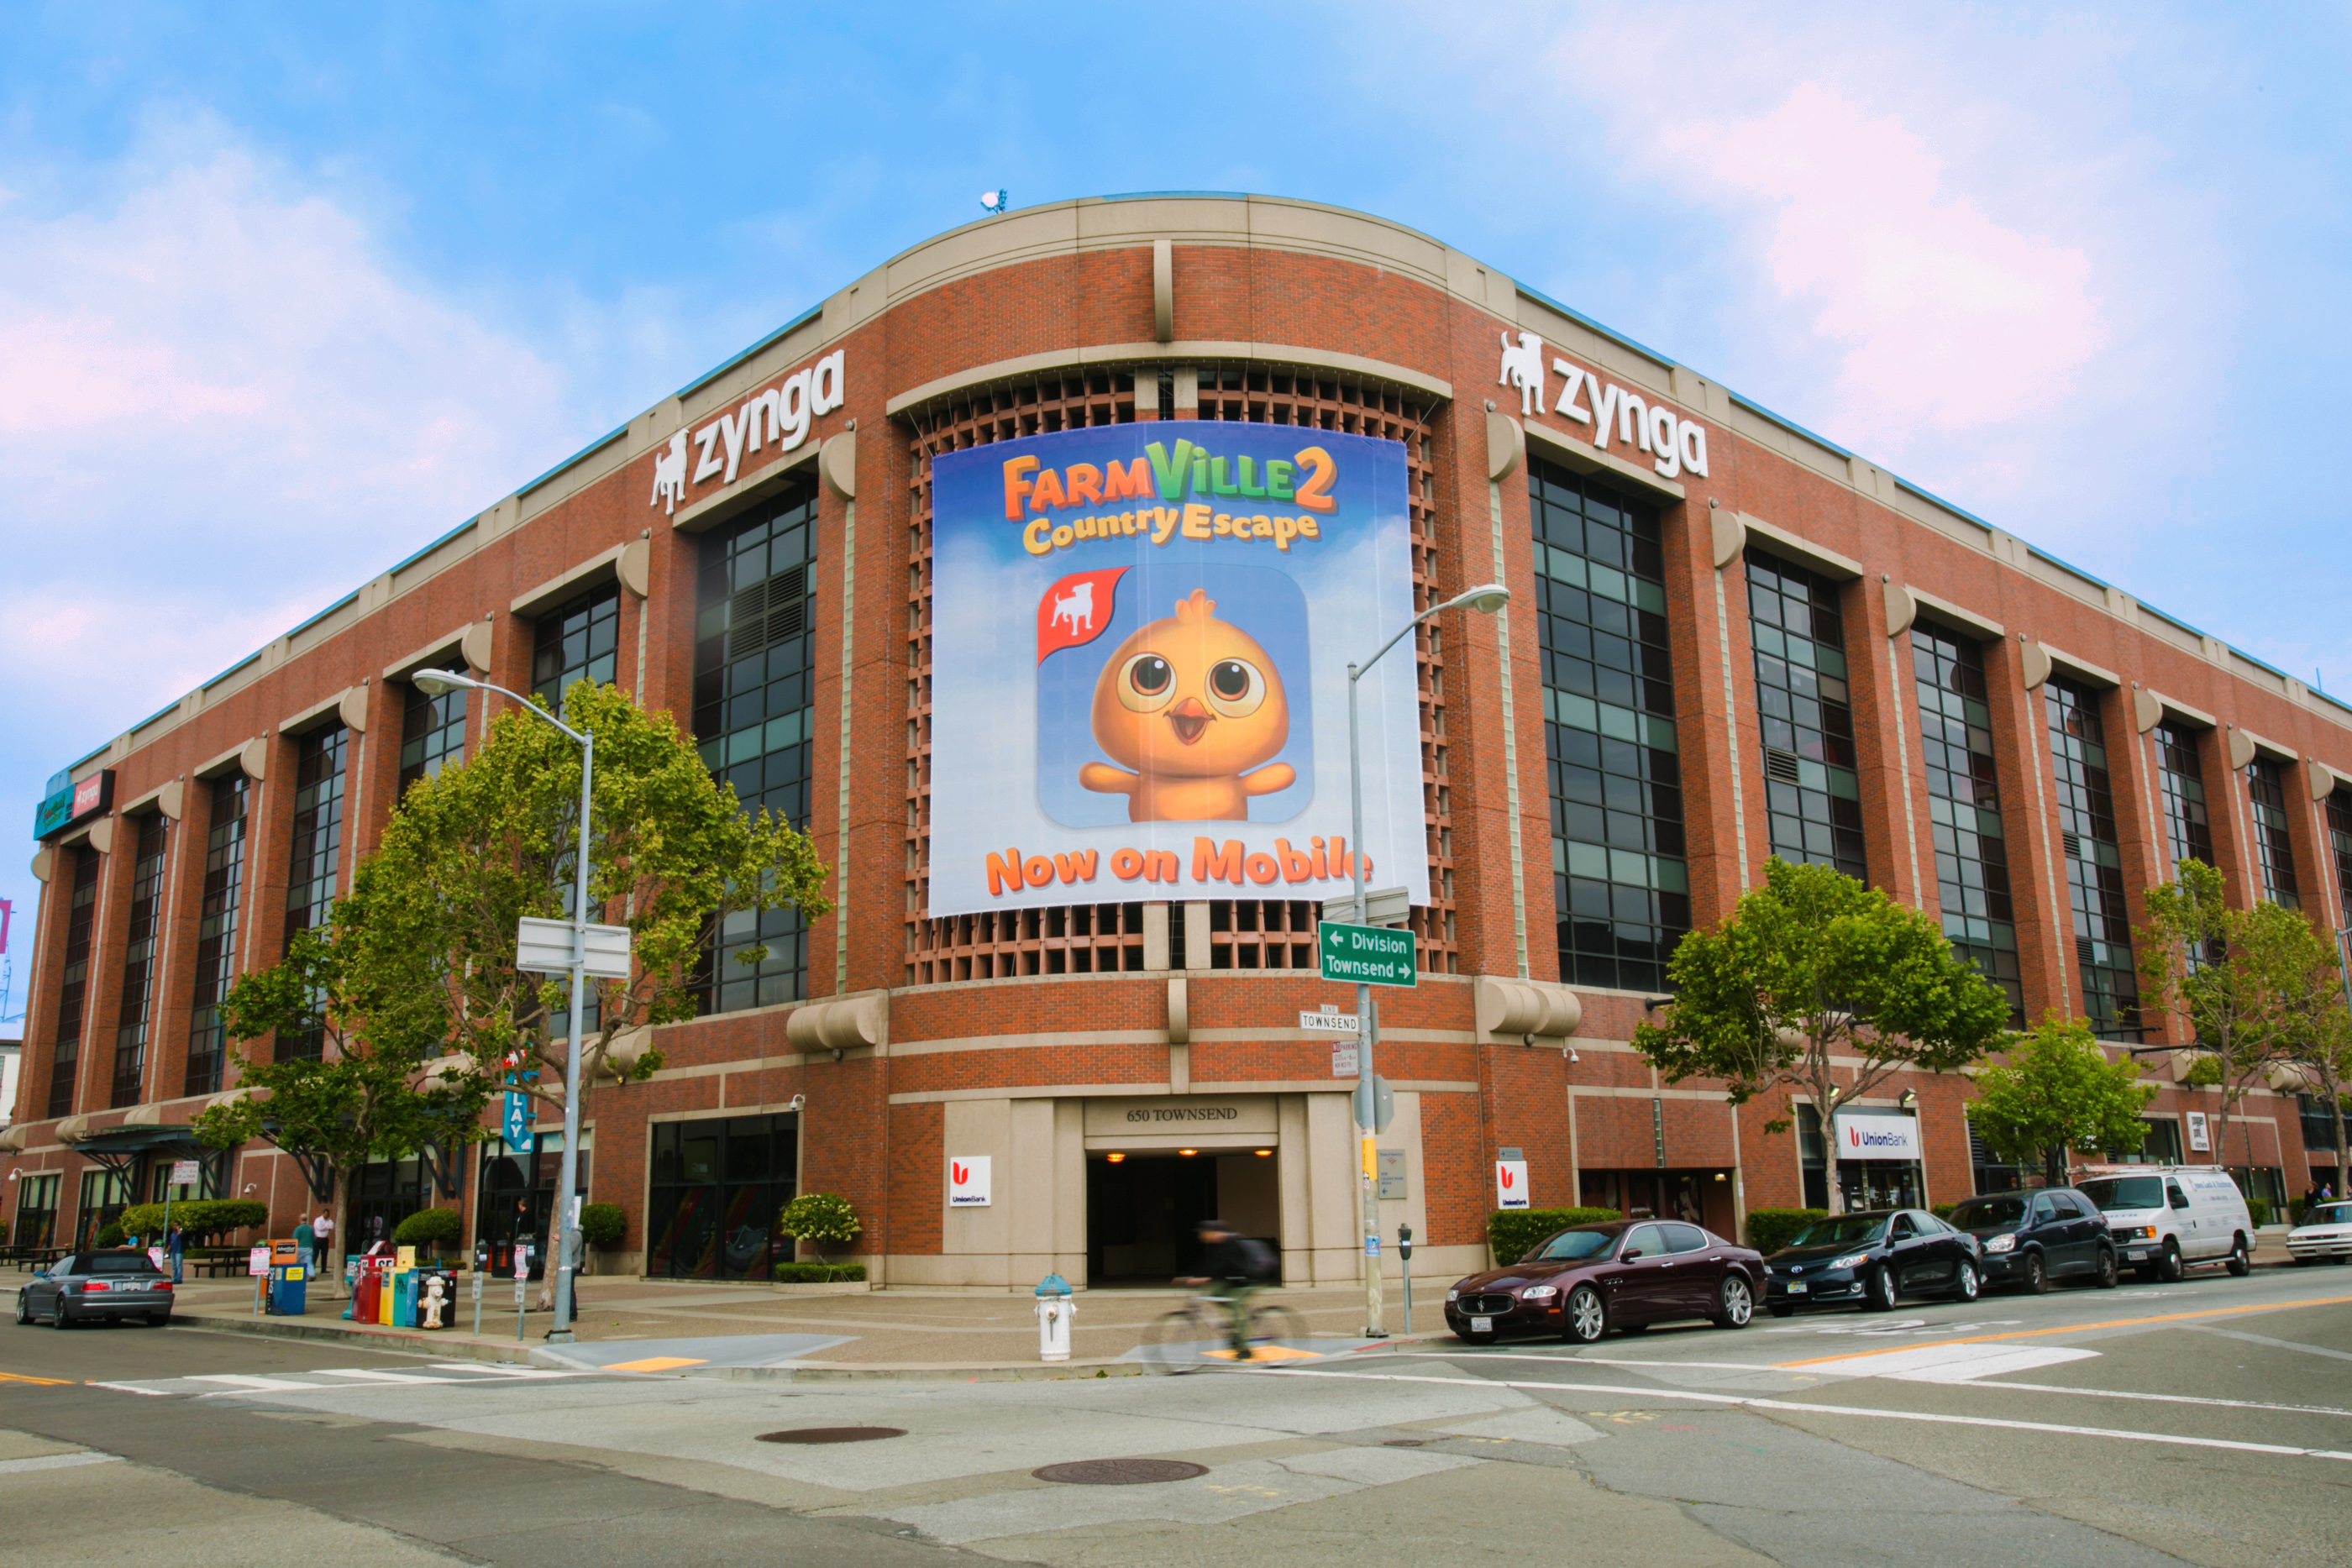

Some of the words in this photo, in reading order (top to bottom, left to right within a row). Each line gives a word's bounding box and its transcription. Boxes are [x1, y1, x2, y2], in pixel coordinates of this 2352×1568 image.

[692, 349, 845, 485] zynga
[1552, 357, 1709, 479] zynga
[1022, 506, 1179, 556] Country
[1181, 503, 1320, 551] Escape
[986, 847, 1098, 896] Now
[1110, 847, 1179, 883] on
[1191, 836, 1374, 884] Mobile
[1352, 932, 1407, 954] Division
[1326, 955, 1394, 978] Townsend
[1303, 1015, 1357, 1030] TOWNSEND
[511, 1078, 523, 1138] LAY
[1126, 1109, 1150, 1122] 650
[1153, 1107, 1237, 1121] TOWNSEND
[1862, 1132, 1908, 1146] UnionBank
